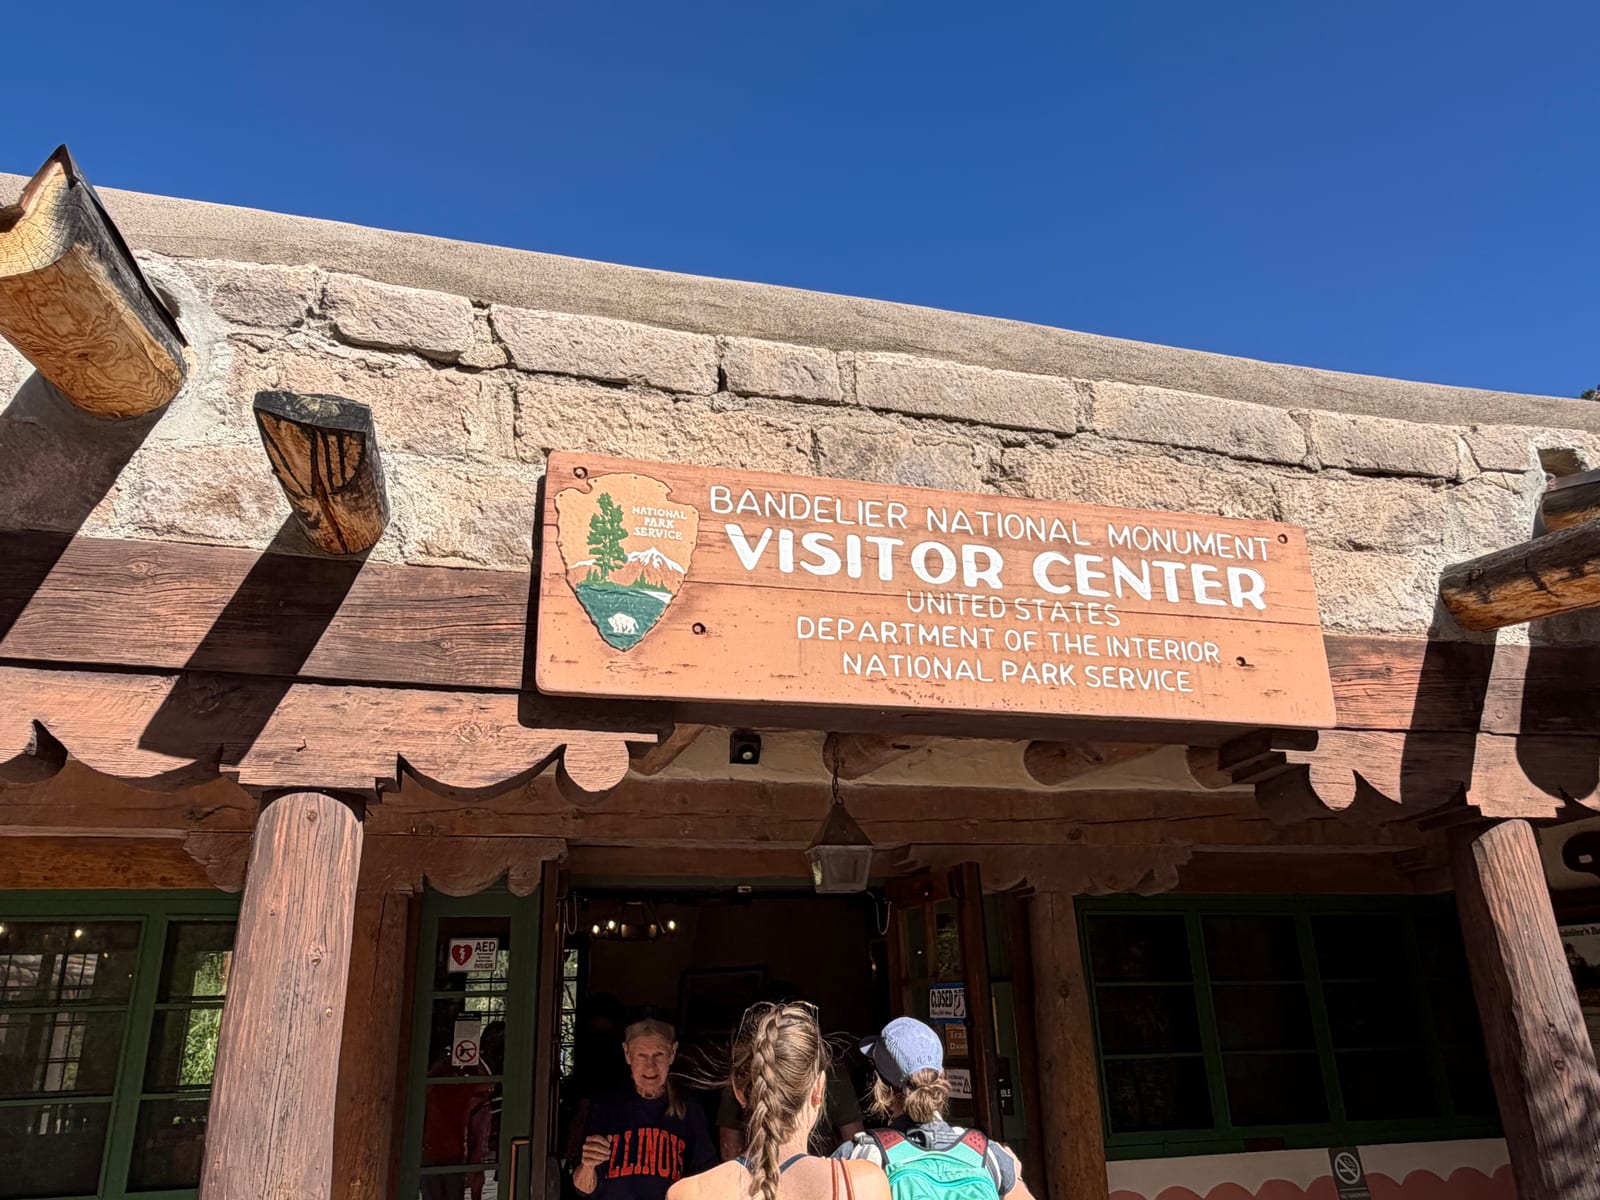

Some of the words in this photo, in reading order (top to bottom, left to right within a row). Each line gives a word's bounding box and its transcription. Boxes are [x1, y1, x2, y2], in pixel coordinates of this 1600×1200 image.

[632, 506, 687, 520] NATIONAL
[644, 517, 675, 529] PARK
[709, 485, 909, 530] BANDELIER
[926, 507, 1092, 547] NATIONAL
[1107, 523, 1271, 561] MONUMENT
[633, 527, 683, 541] SERVICE
[724, 523, 1005, 591] VISITOR
[1032, 550, 1267, 611] CENTER
[906, 590, 1007, 619] UNITED
[1013, 597, 1121, 628] STATES
[796, 615, 995, 650] DEPARTMENT
[1004, 629, 1038, 652] OF
[1047, 631, 1100, 657] THE
[1105, 635, 1221, 664] INTERIOR
[842, 652, 994, 683] NATIONAL
[1001, 659, 1077, 686] PARK
[1084, 665, 1194, 693] SERVICE
[475, 942, 496, 952] AED
[931, 990, 953, 1008] CLOSED
[607, 1128, 686, 1181] LLINOIS
